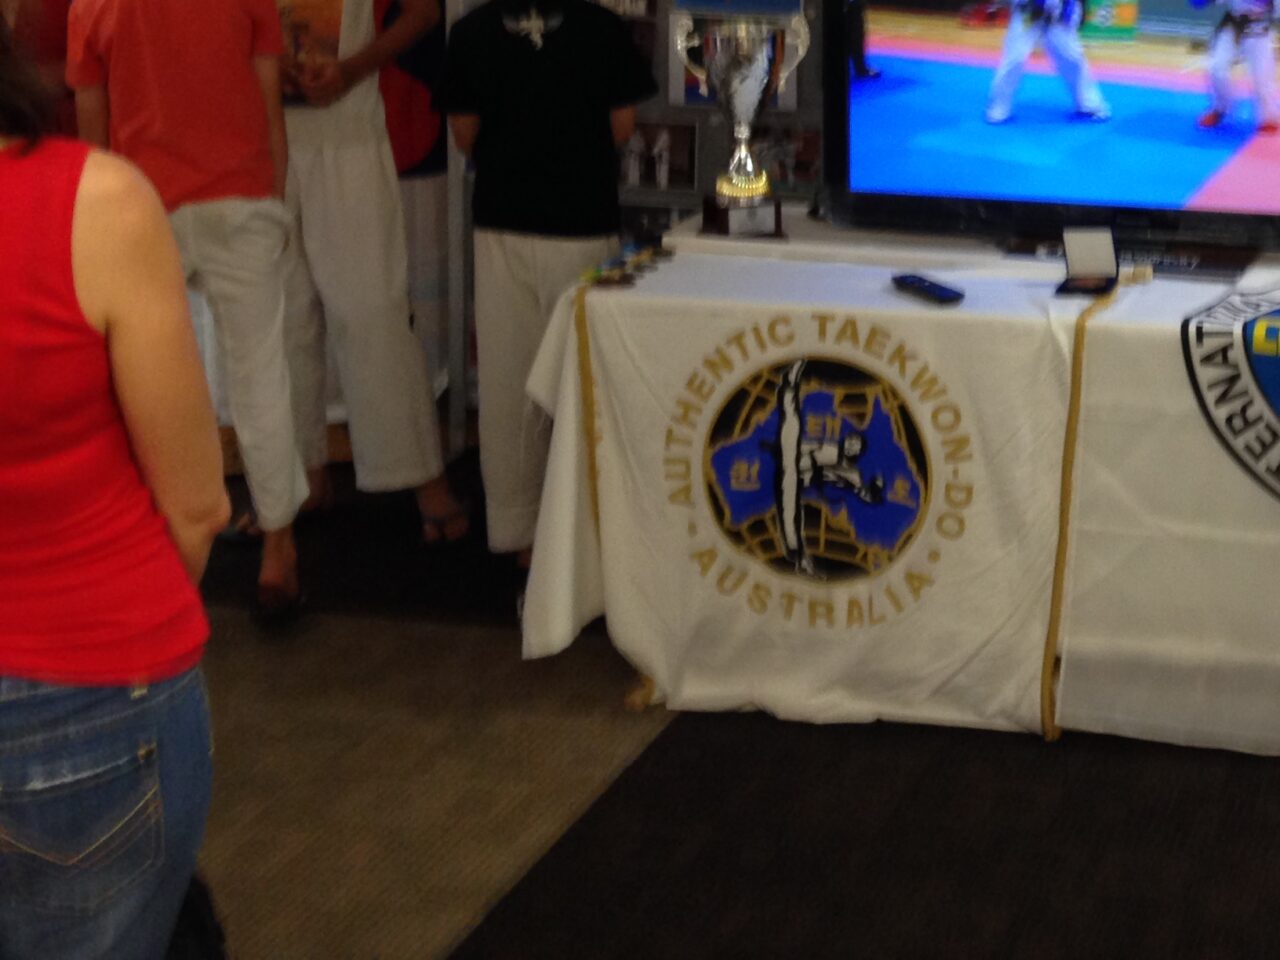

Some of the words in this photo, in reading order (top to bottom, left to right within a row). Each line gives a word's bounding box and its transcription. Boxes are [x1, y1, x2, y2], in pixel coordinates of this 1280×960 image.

[663, 315, 795, 507] AUTHENTIC
[811, 313, 974, 540] TAEKWON-DO
[690, 546, 934, 629] AUSTRALIA
